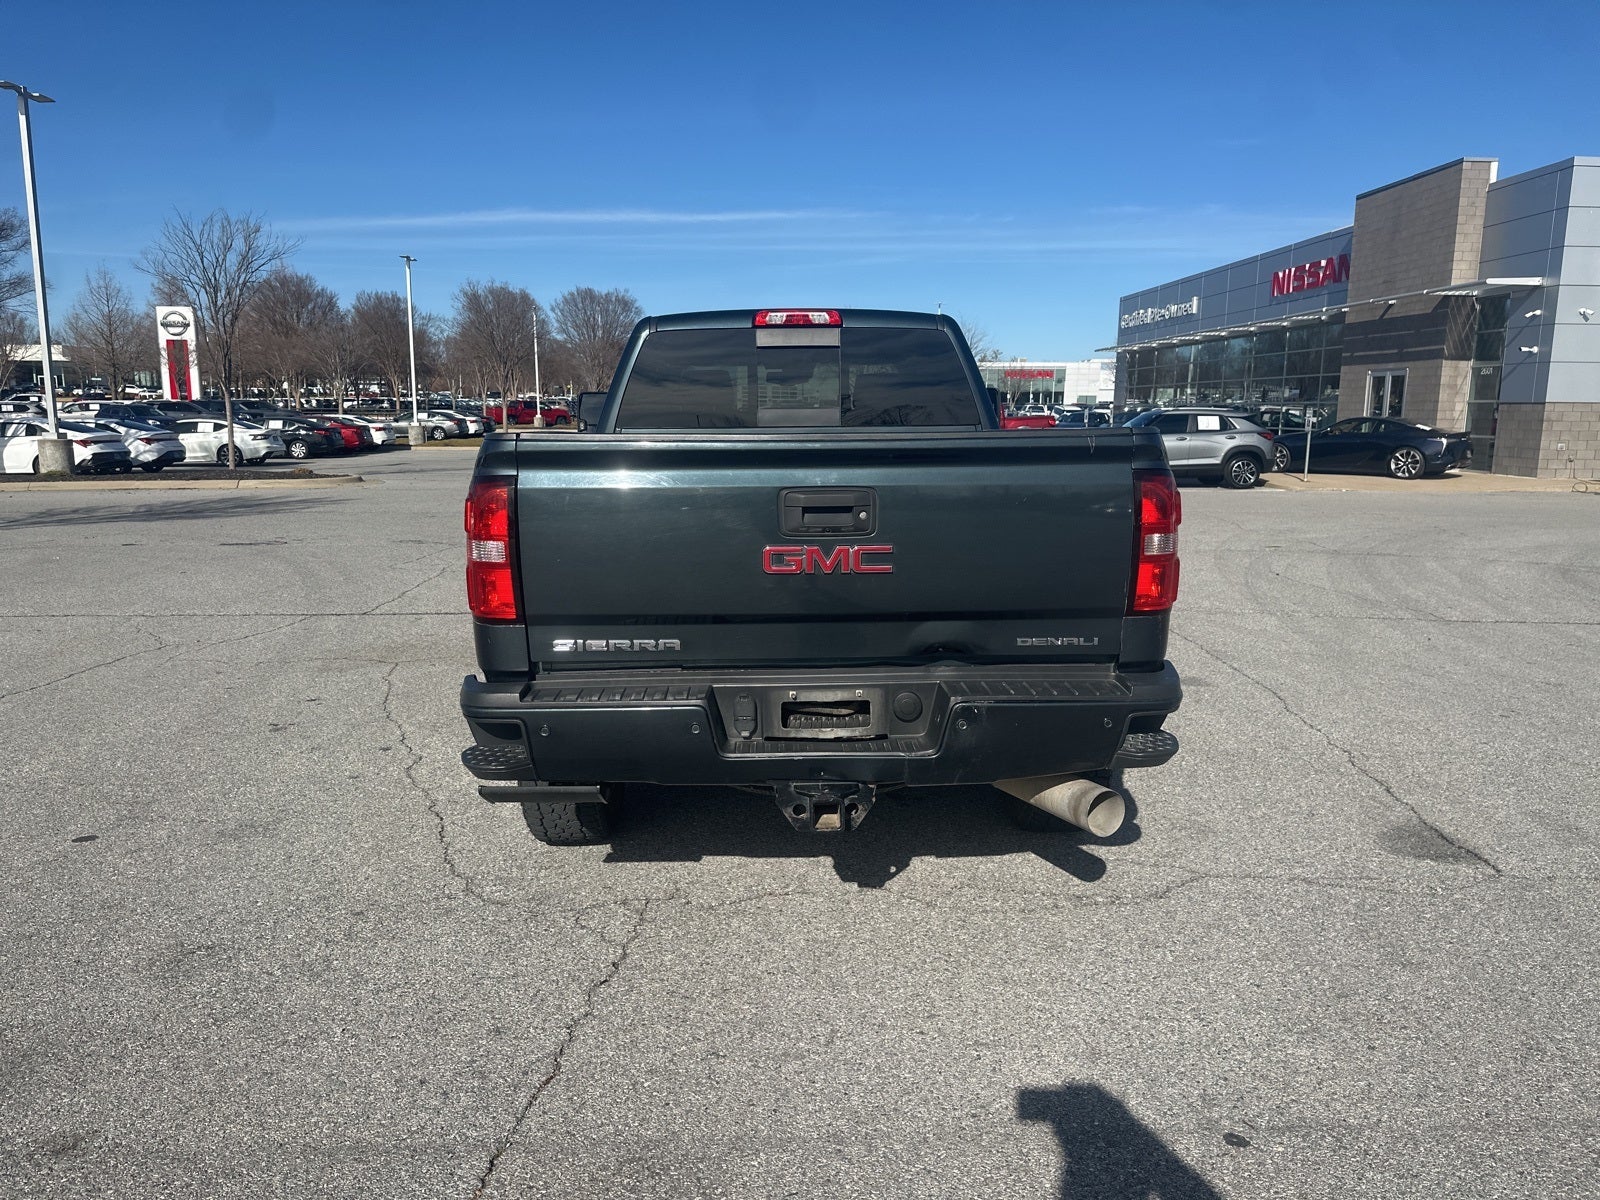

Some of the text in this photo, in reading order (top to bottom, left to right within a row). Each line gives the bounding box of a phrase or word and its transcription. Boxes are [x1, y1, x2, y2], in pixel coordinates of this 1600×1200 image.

[1272, 254, 1350, 297] NISSAN
[762, 545, 893, 574] GMC
[552, 639, 681, 652] SIERRA
[1016, 637, 1099, 646] DENALI
